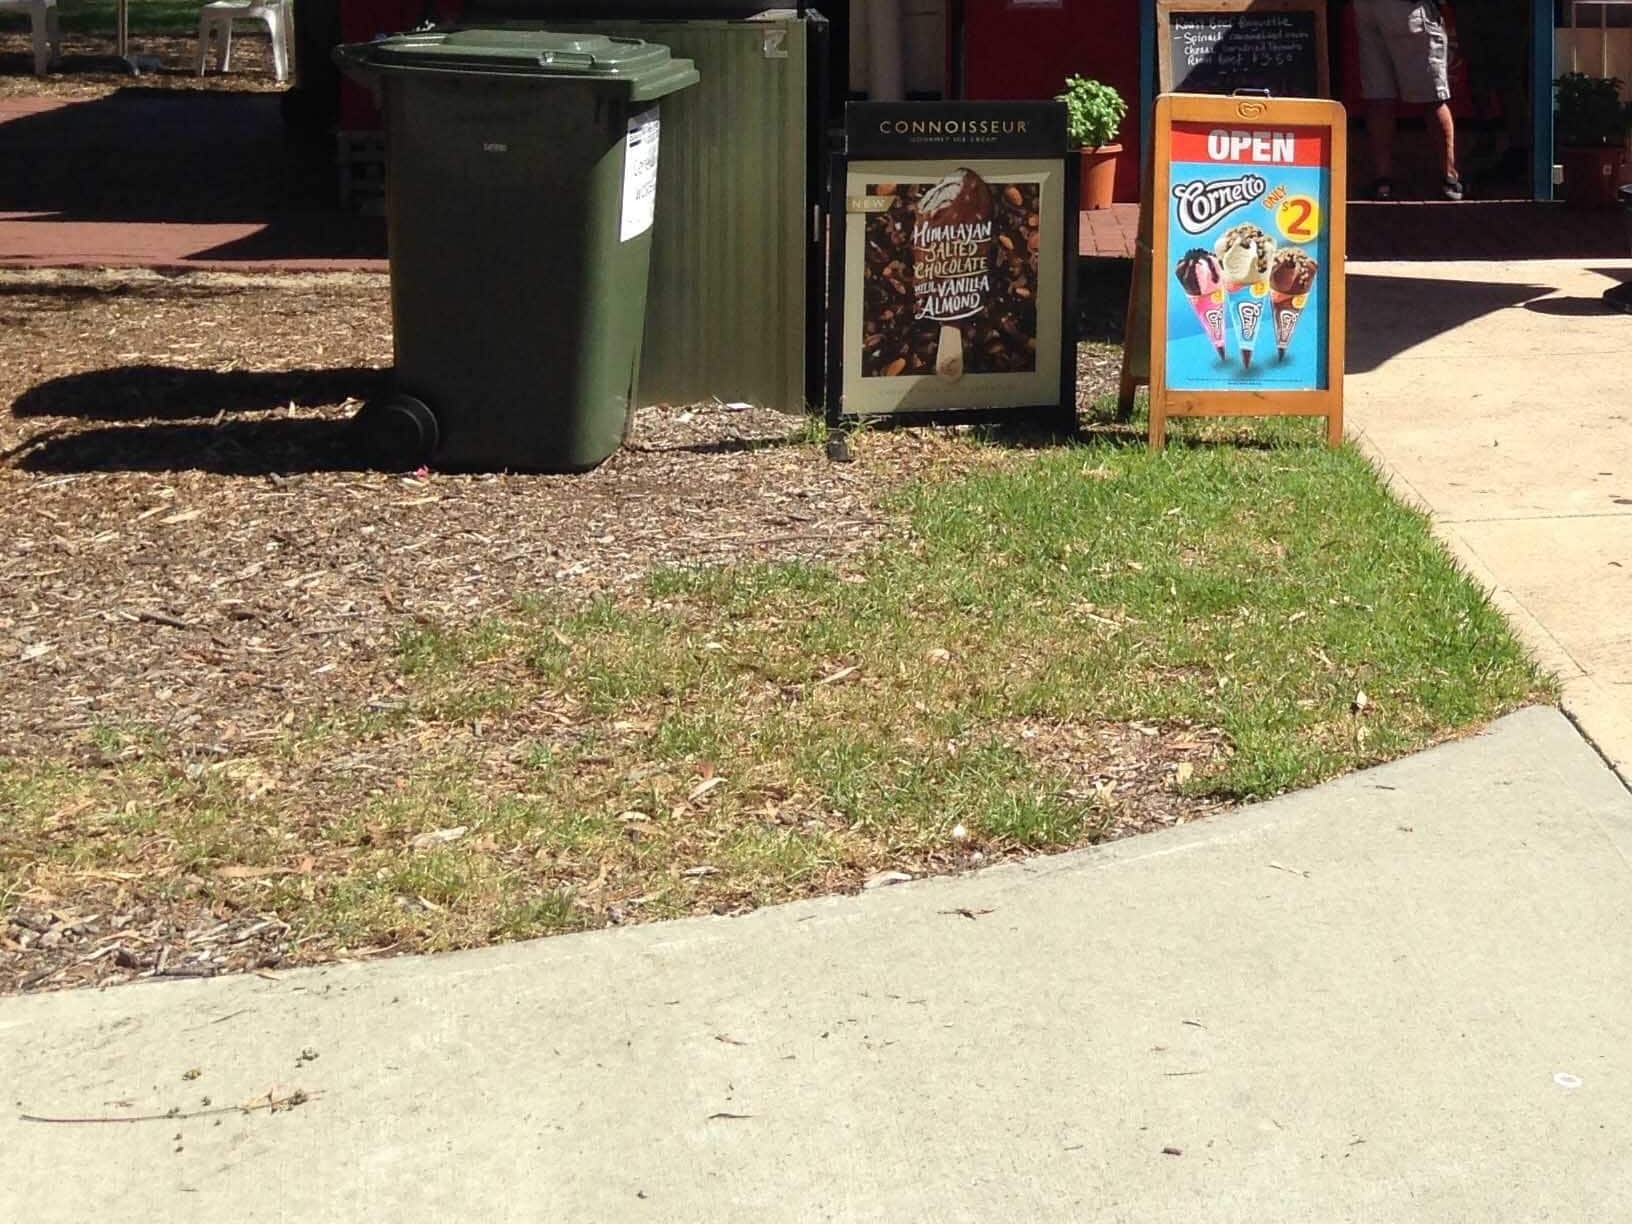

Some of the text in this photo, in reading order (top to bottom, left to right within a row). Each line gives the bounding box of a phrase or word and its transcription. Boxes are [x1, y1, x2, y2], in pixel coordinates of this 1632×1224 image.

[879, 120, 1027, 134] CONNOISSEUR
[1207, 130, 1295, 163] OPEN
[851, 199, 886, 209] NEW
[1173, 176, 1265, 234] Cornetto
[1263, 185, 1288, 209] ONLY
[913, 221, 992, 247] HIMALAYAN
[922, 240, 978, 263] SALTED
[912, 257, 990, 280] CHOCOLATE
[937, 275, 990, 297] VANILLA
[917, 293, 983, 320] ALMOND
